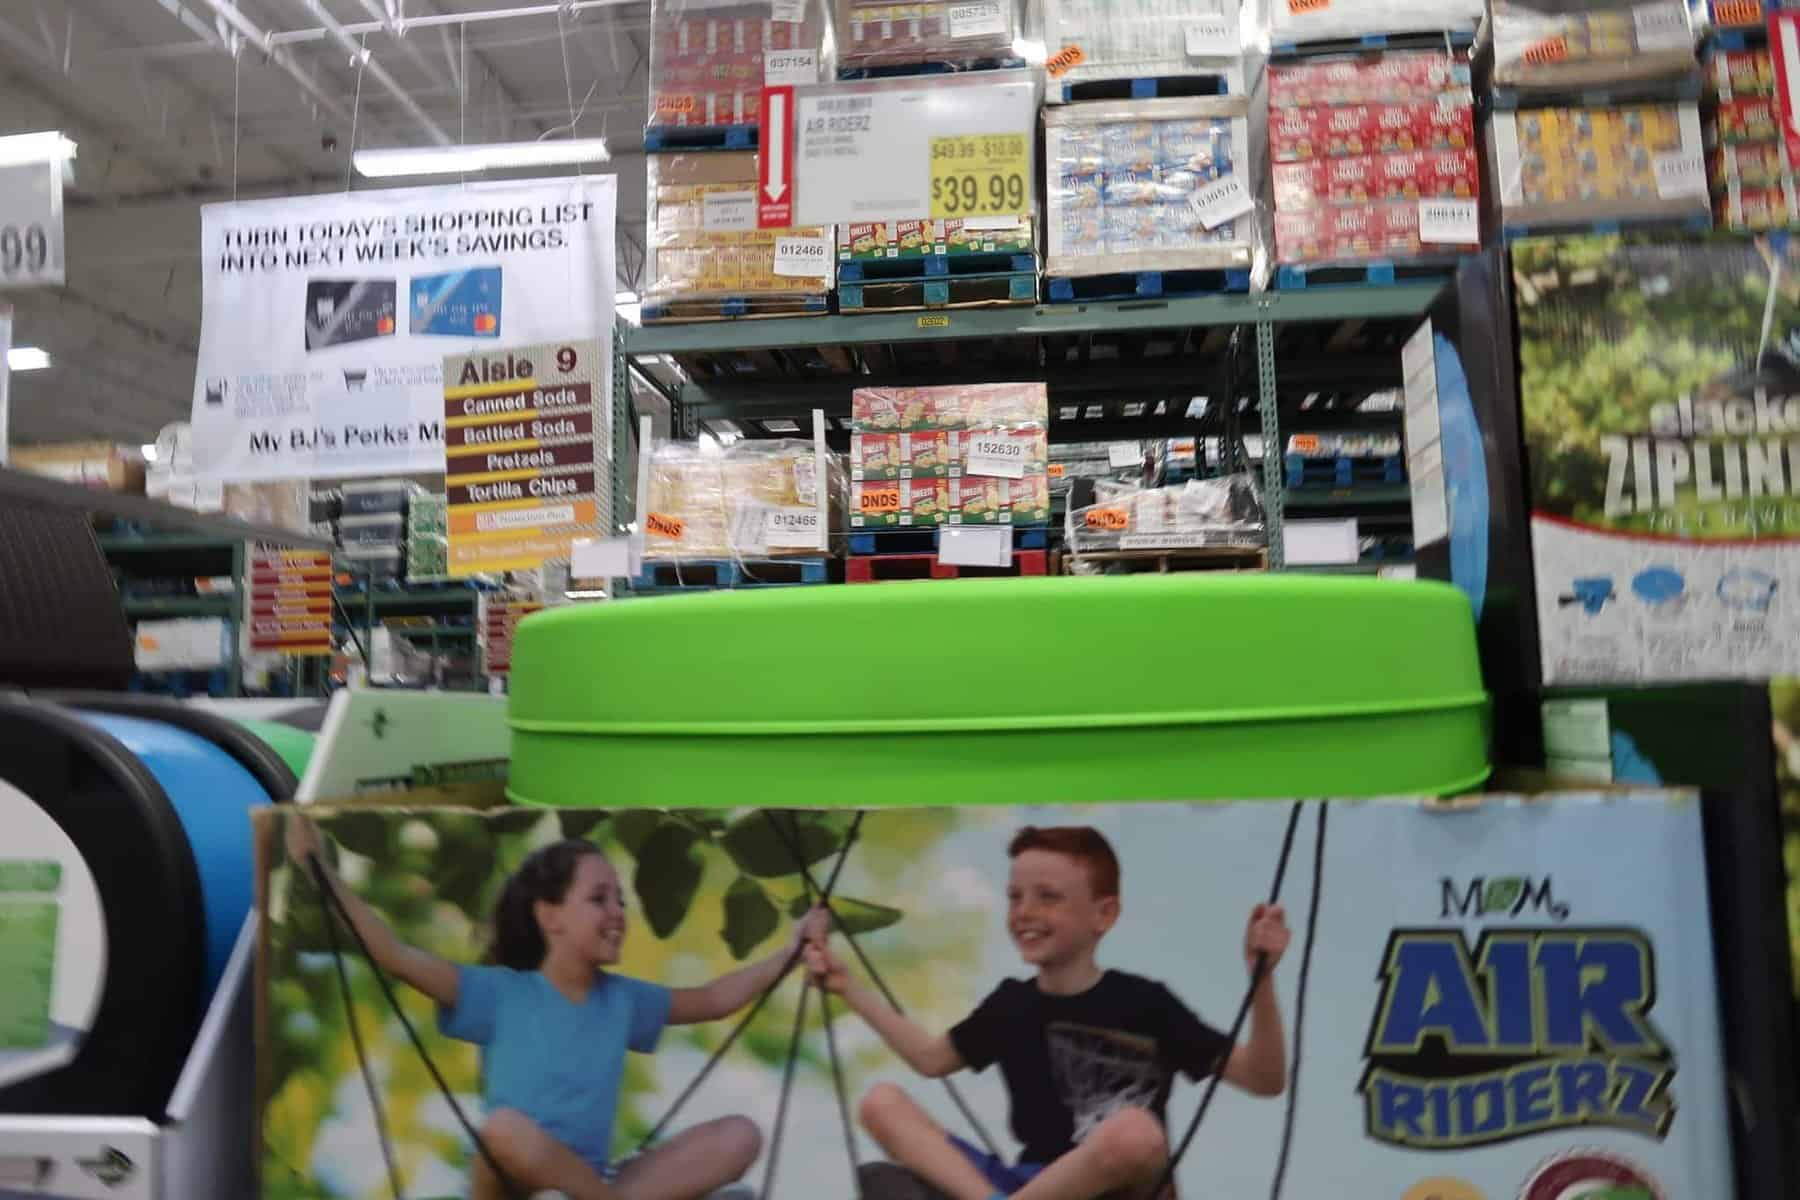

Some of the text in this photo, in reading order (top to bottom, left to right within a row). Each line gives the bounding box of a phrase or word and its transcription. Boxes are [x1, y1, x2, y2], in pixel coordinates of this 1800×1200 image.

[932, 172, 1024, 215] $39.99
[223, 202, 594, 248] TURN TODAY'S SHOPPING LIST
[220, 228, 569, 273] INTO NEXT WEEK'S SAVINGS.
[780, 244, 824, 256] 012466
[459, 353, 534, 385] Aisle
[556, 347, 577, 373] 9
[463, 387, 577, 417] Canned Soda
[290, 426, 336, 449] BJ's
[418, 421, 445, 443] M
[463, 419, 576, 450] Bottled Soda
[976, 442, 1020, 457] 152630
[487, 450, 555, 470] Pretzels
[465, 478, 577, 502] Tortilla Chips
[861, 493, 898, 508] DNDS
[1370, 929, 1662, 1056] AIR
[1366, 1058, 1674, 1144] RIDERZ
